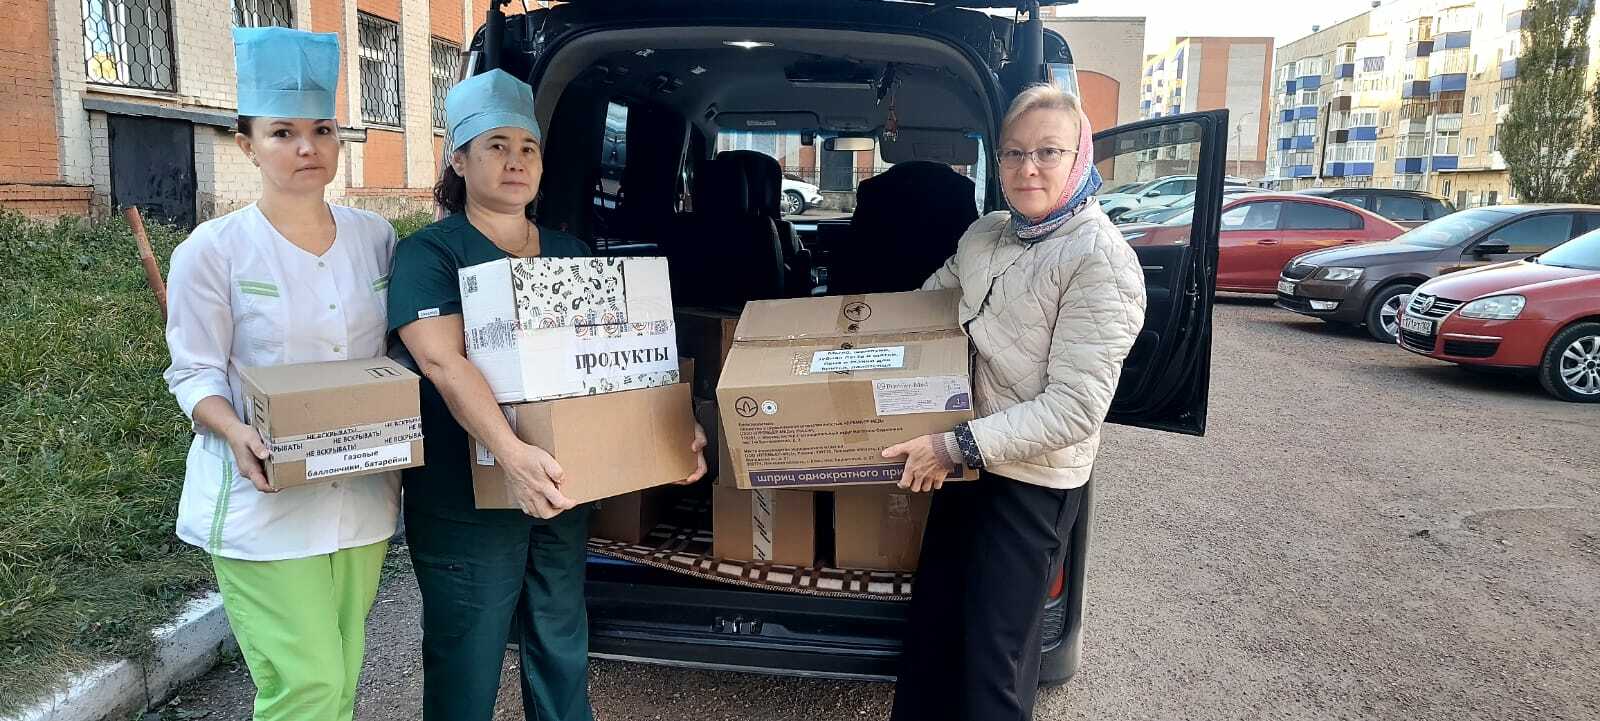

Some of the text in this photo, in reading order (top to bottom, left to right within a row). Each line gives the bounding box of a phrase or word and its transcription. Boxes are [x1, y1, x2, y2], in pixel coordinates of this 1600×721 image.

[575, 347, 669, 374] продукты
[344, 430, 382, 442] ВСКРЫВАТЬ!
[394, 432, 422, 442] ВСКРЫВА
[272, 443, 303, 452] РЫВАТЬ!
[306, 444, 357, 458] НЕ ВСКРЫВАТЬ!
[344, 451, 379, 460] Газовые
[307, 456, 408, 477] баллончики, батарейки
[757, 467, 904, 484] шприц однократного при
